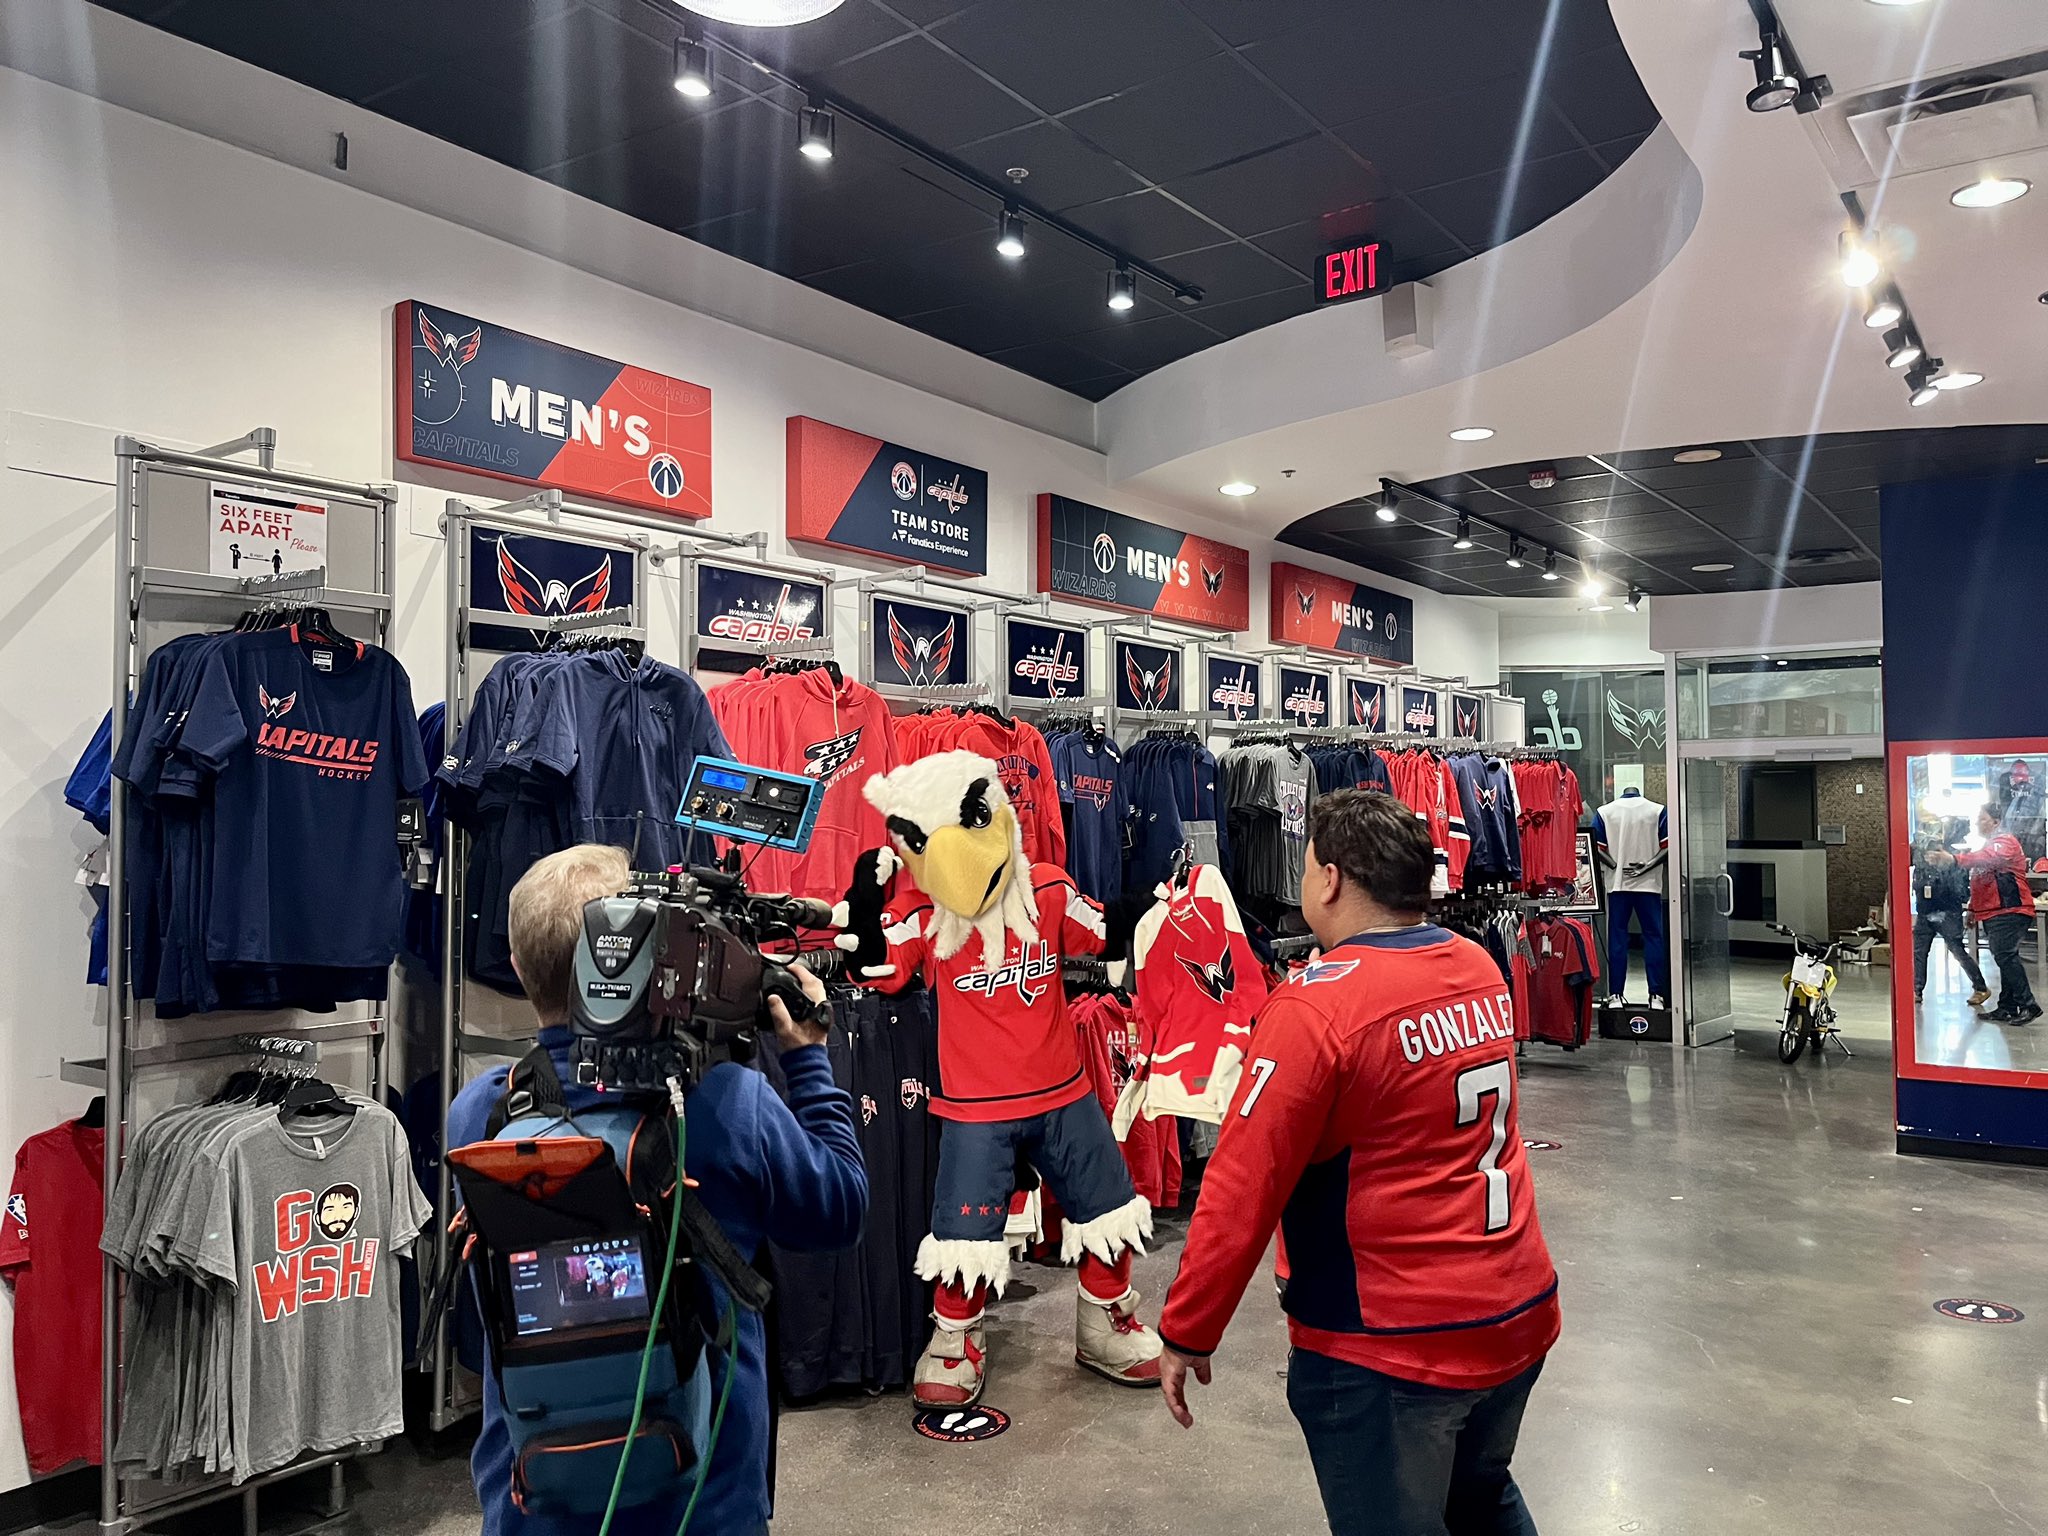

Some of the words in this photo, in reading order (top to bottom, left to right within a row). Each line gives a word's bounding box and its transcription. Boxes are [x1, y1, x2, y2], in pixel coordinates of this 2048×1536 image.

[1326, 243, 1379, 298] EXIT
[491, 377, 652, 460] MEN'S
[412, 426, 519, 467] CAPITALS
[219, 518, 293, 541] APART
[220, 503, 248, 519] SIX
[253, 508, 293, 526] FEET
[891, 509, 927, 531] TEAM
[930, 519, 969, 542] STORE
[289, 537, 318, 553] Please
[907, 533, 934, 550] Fanatics
[934, 541, 969, 558] Experience
[1126, 546, 1191, 589] MEN'S
[1052, 568, 1117, 601] WIZARDS
[728, 608, 773, 621] WASHINGTON
[1331, 600, 1374, 632] MEN'S
[257, 722, 379, 763] CAPITALS
[318, 767, 370, 781] HOCKEY
[825, 756, 865, 792] APITALS
[598, 935, 633, 944] ANTON
[1238, 1056, 1277, 1119] 7
[1455, 1056, 1512, 1237] 7
[252, 1238, 380, 1323] WSH
